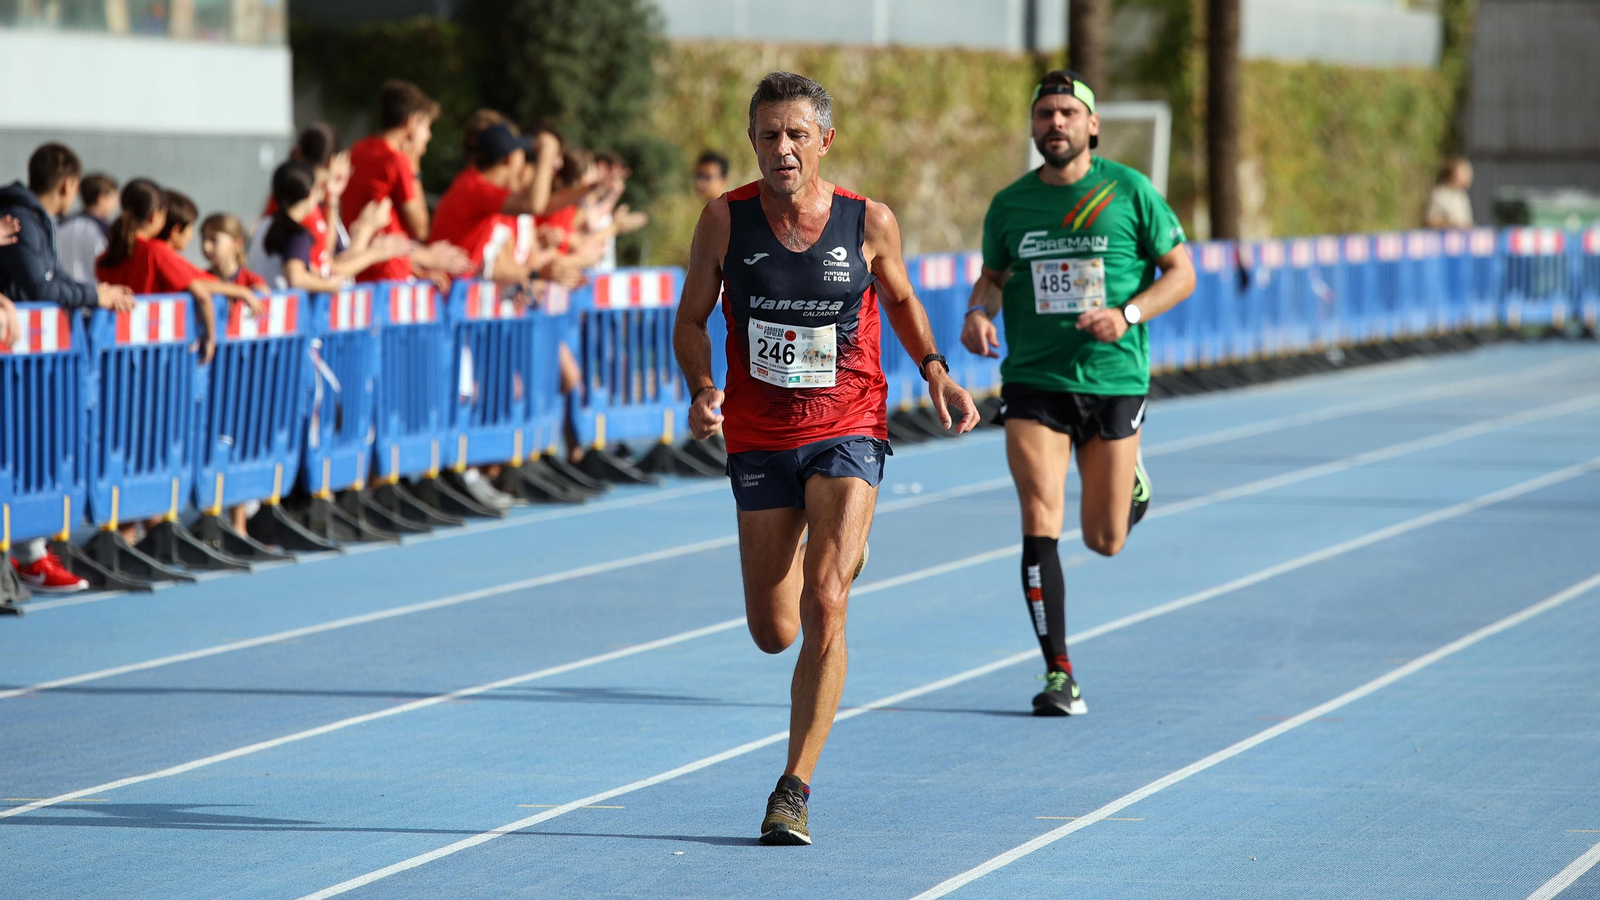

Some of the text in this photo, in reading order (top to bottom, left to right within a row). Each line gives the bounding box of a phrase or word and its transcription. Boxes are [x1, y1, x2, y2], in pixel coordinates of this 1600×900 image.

[1017, 231, 1109, 257] EPREMAIN
[1039, 273, 1071, 293] 485
[749, 296, 844, 311] Vanessa
[757, 338, 796, 365] 246
